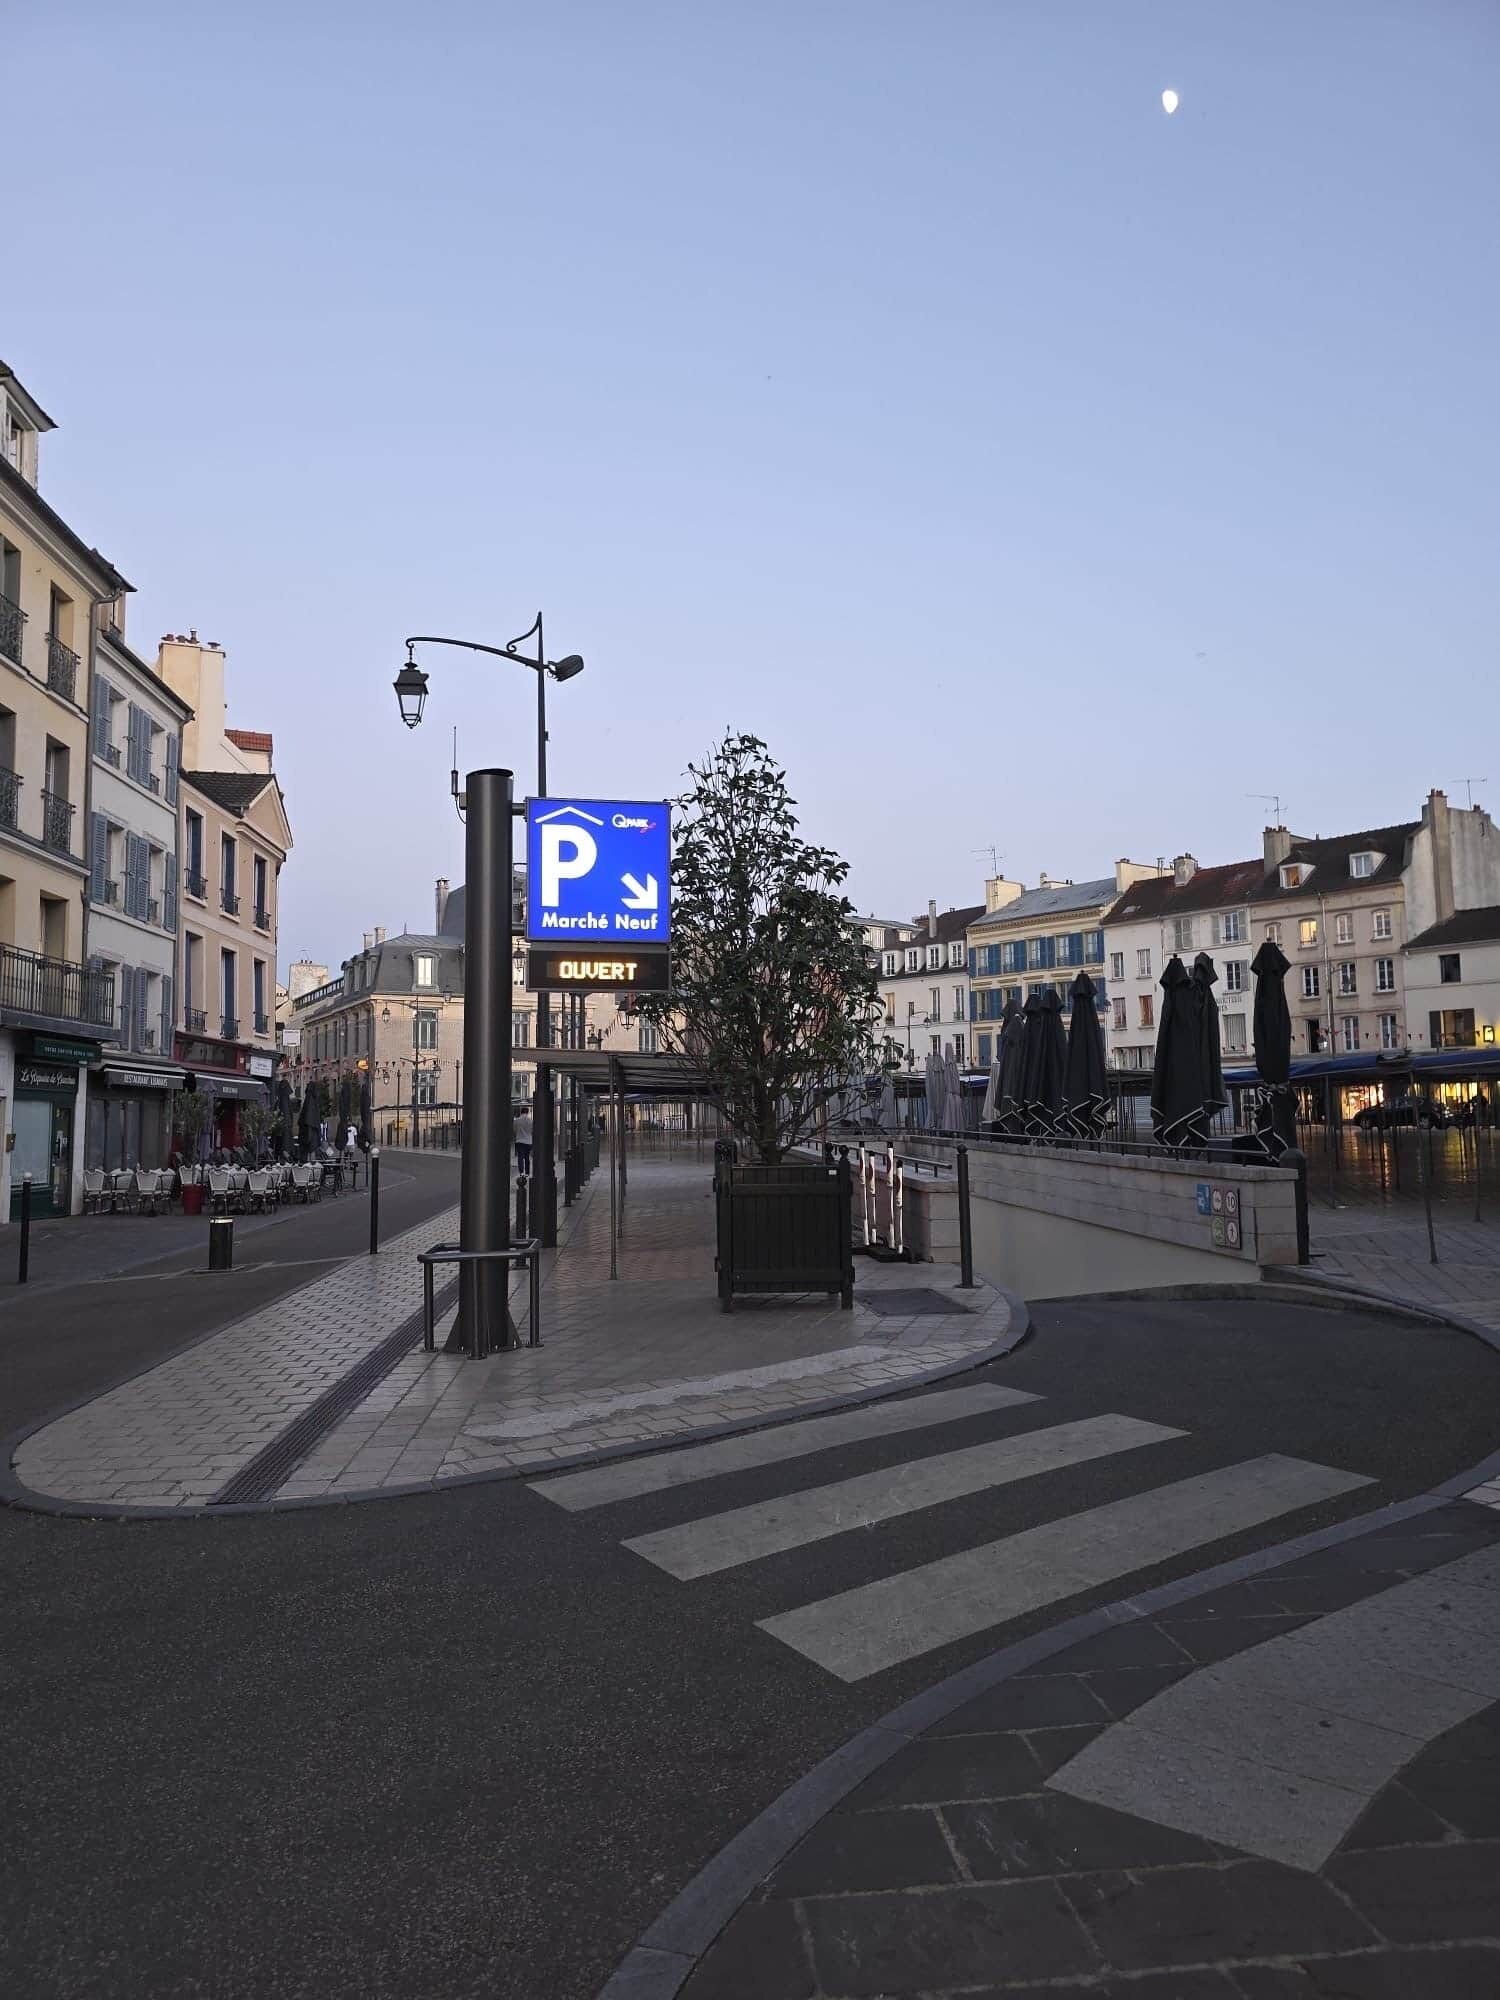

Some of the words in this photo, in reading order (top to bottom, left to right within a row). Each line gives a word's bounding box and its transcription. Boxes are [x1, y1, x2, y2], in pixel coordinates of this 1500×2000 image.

[542, 824, 597, 907] P
[542, 912, 609, 929] Marché
[615, 913, 658, 930] Neuf
[559, 961, 637, 981] OUVERT
[1227, 1196, 1236, 1208] 10
